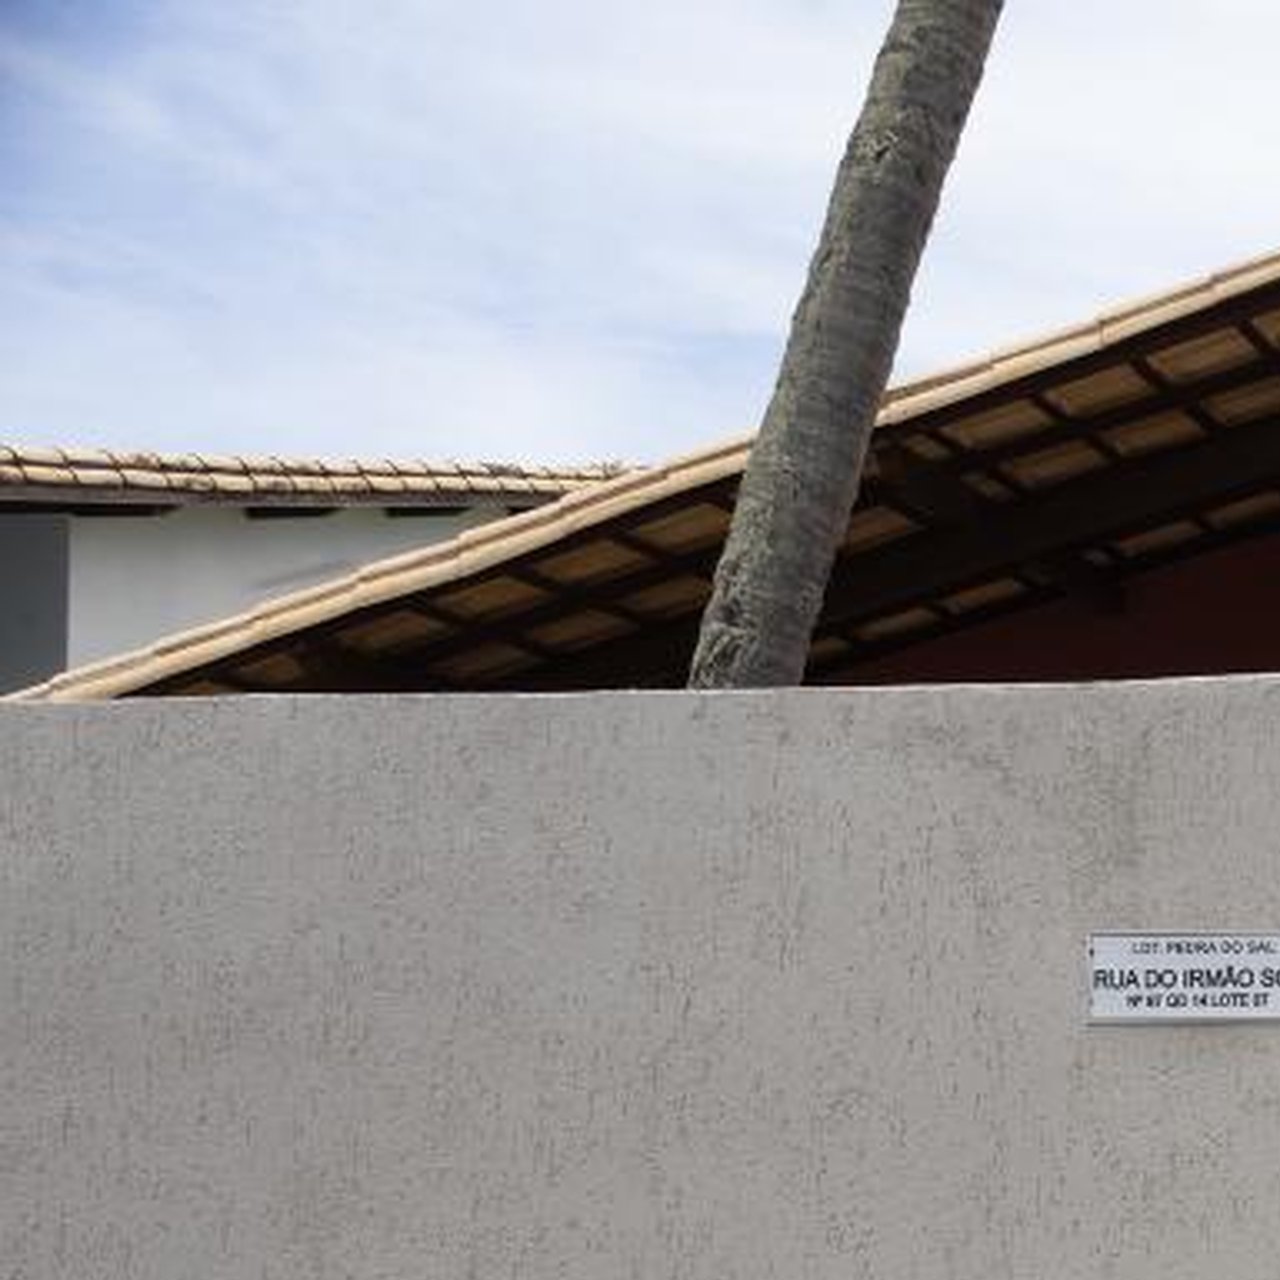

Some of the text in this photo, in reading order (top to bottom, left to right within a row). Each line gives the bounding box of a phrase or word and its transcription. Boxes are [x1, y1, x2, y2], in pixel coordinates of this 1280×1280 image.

[1093, 968, 1140, 989] RUA
[1145, 968, 1178, 989] DO
[1182, 964, 1255, 989] IRMÃO
[1210, 992, 1249, 1007] LOTE
